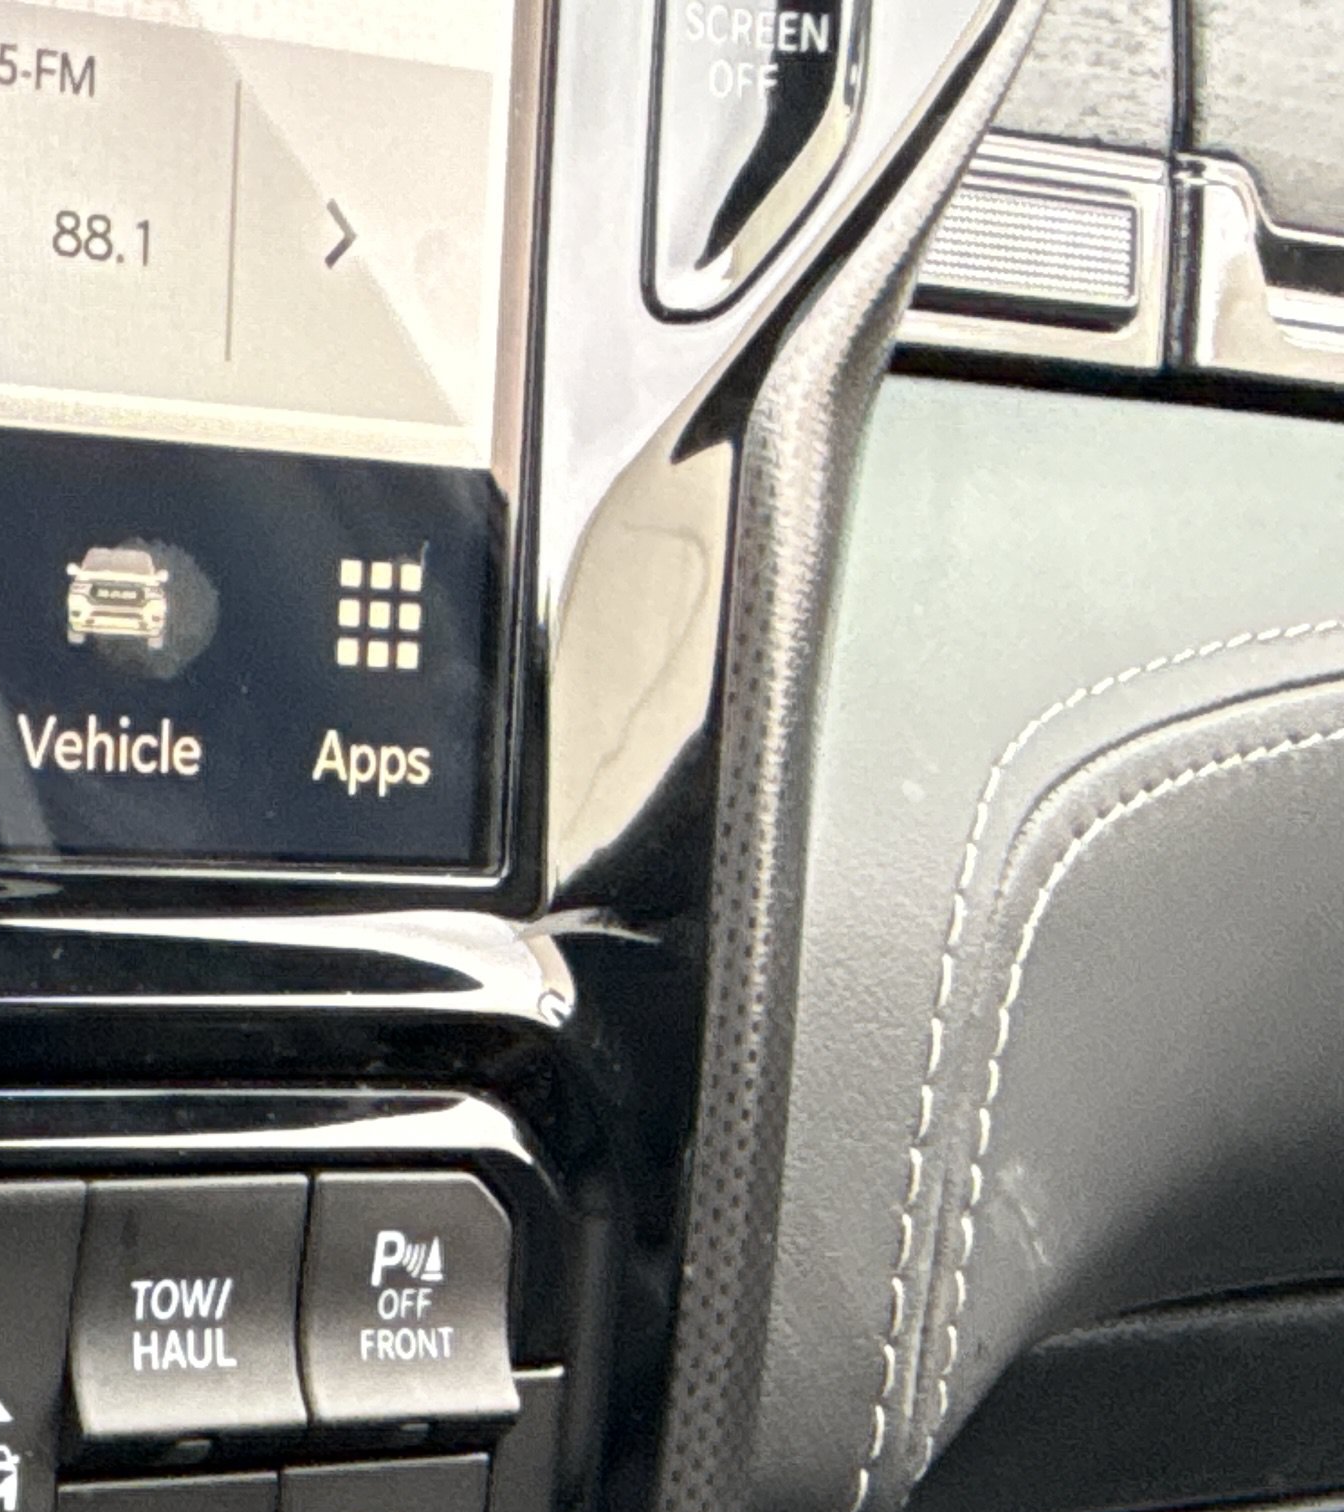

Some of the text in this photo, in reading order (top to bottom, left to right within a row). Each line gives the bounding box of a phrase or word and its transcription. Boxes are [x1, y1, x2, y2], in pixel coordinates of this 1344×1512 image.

[685, 2, 830, 54] SCREEN
[709, 59, 780, 102] OFF
[52, 209, 152, 268] 88.1
[17, 712, 203, 778] Vehicle
[312, 729, 432, 798] Apps
[130, 1276, 235, 1323] TOW/
[377, 1288, 433, 1320] OFF
[131, 1328, 238, 1372] HAUL
[359, 1326, 455, 1362] FRONT
